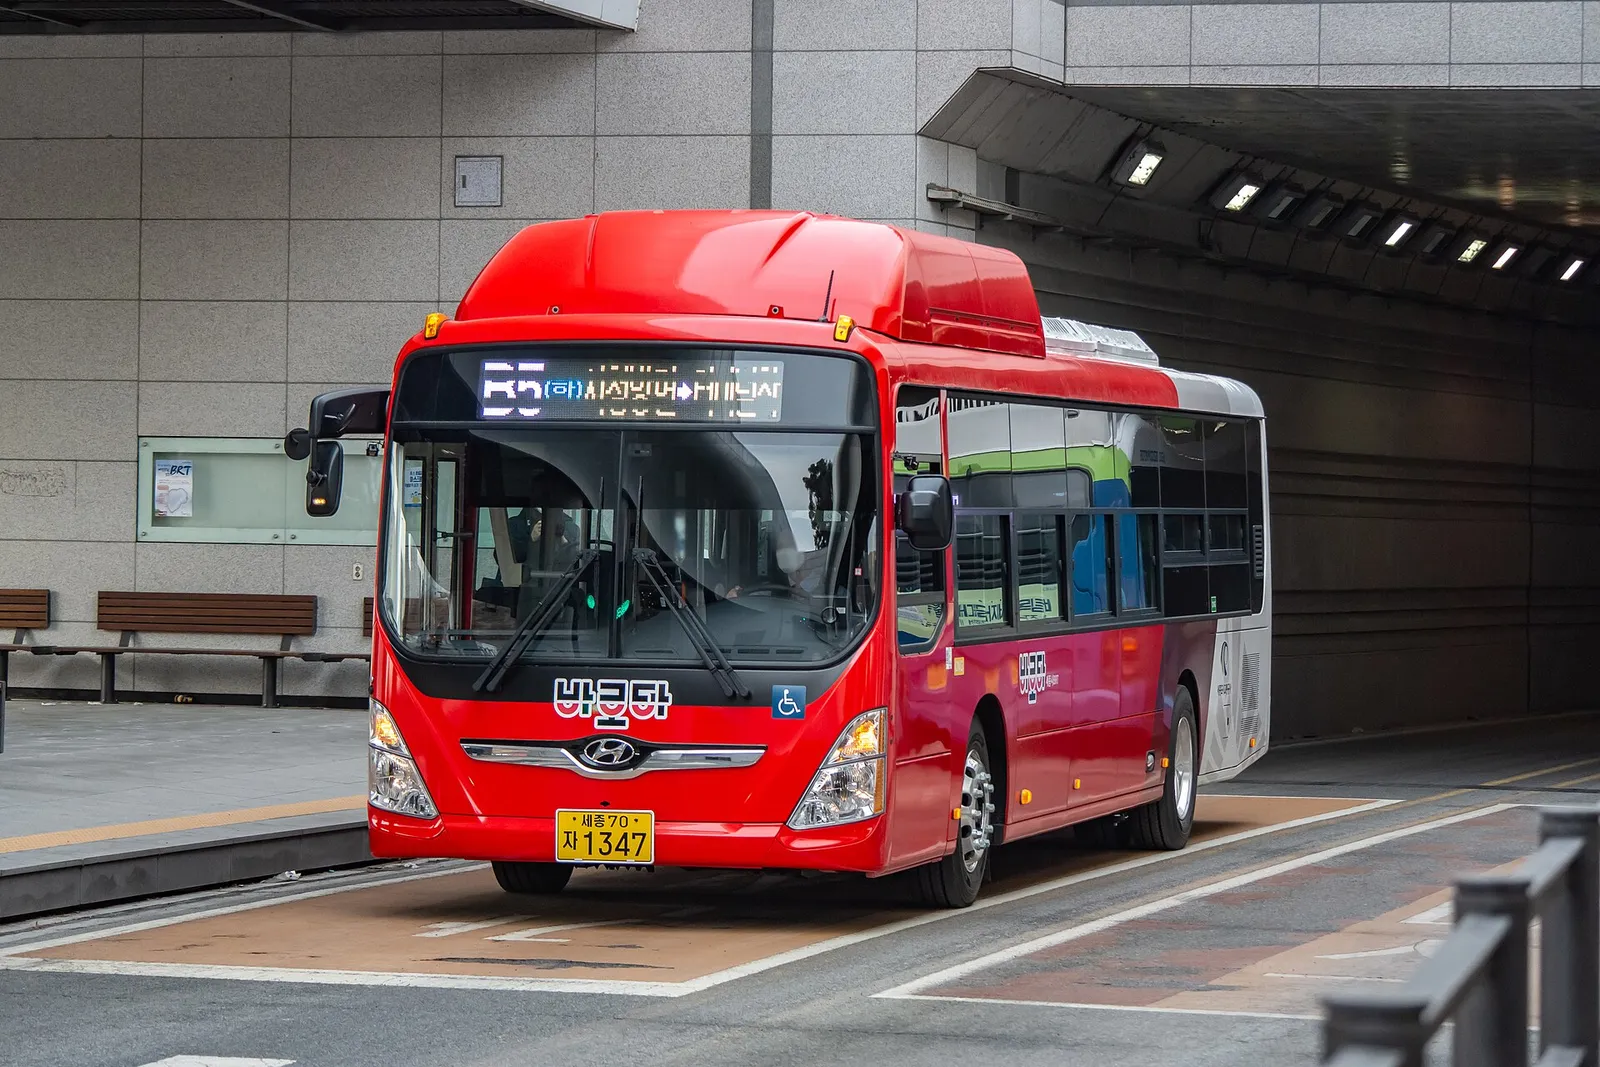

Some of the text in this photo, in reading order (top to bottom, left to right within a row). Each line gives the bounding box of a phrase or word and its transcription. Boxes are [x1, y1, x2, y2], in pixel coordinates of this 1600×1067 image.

[170, 465, 192, 476] BRT
[1019, 651, 1046, 704] 바로타
[554, 678, 672, 729] 바로타
